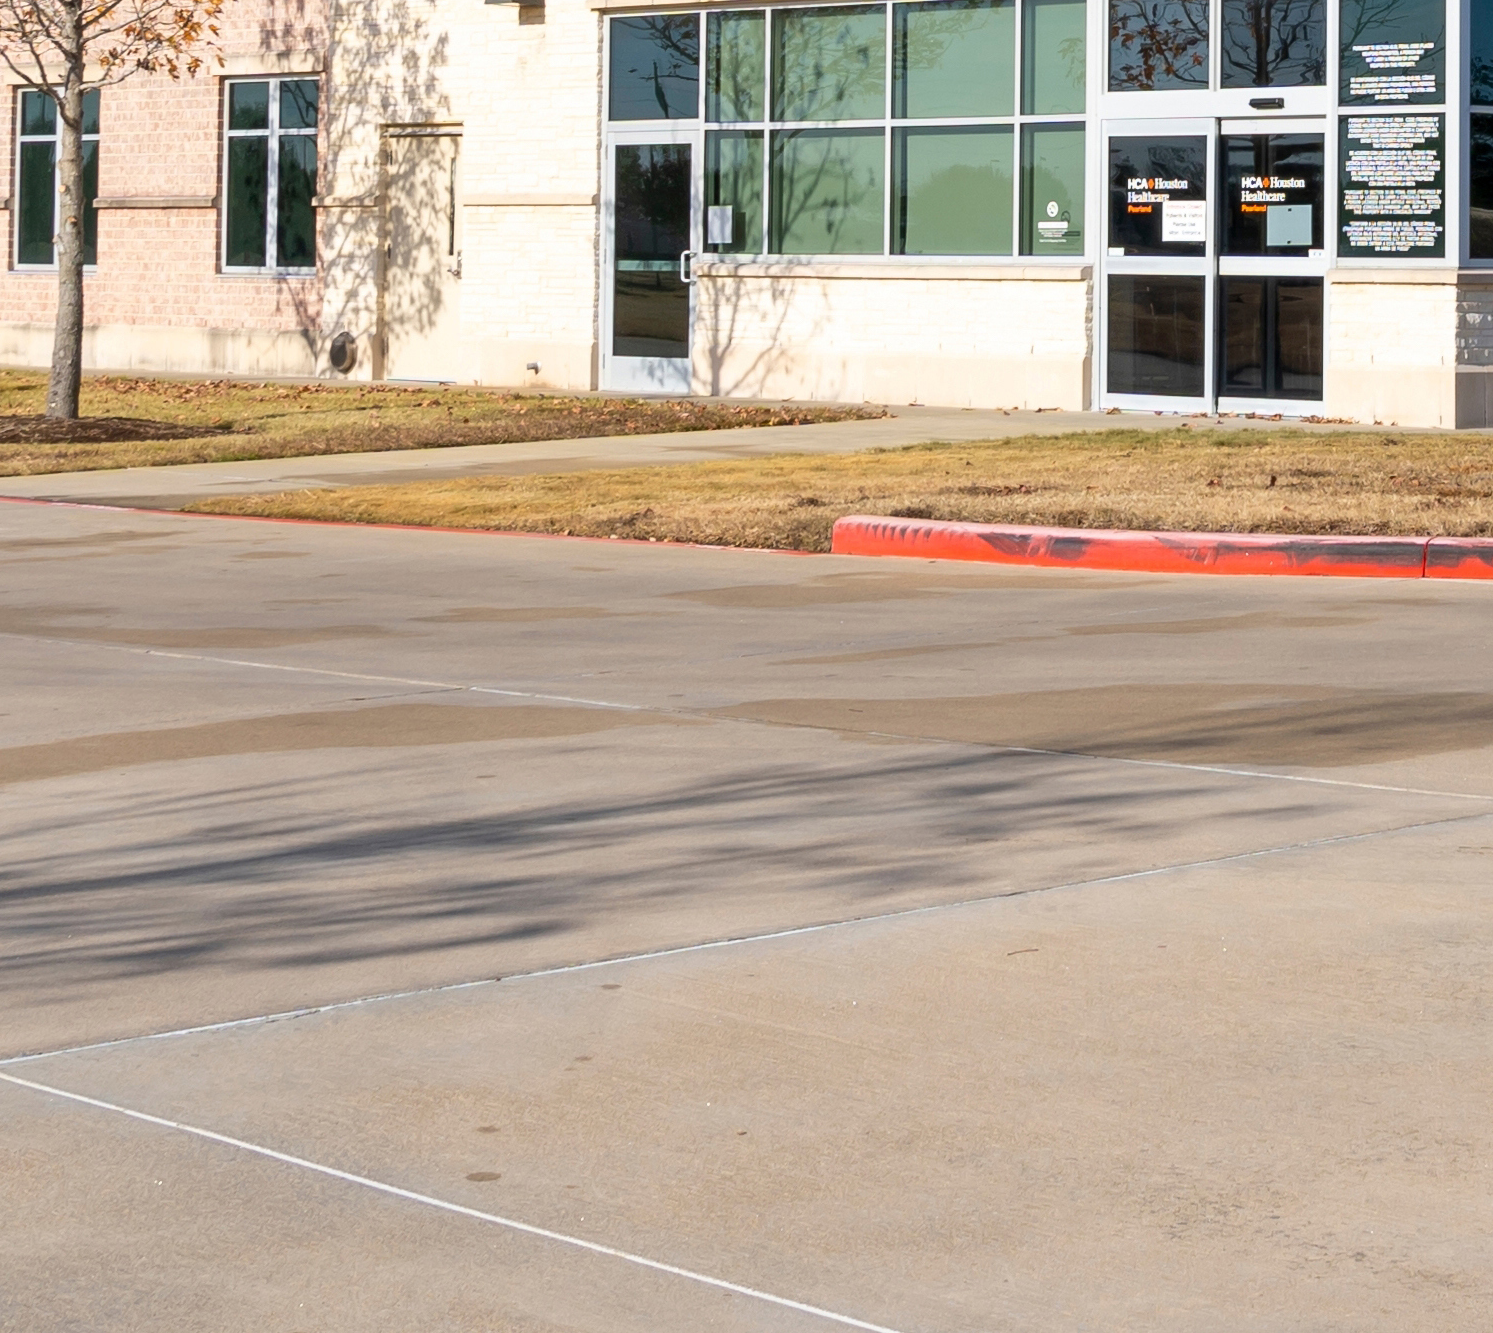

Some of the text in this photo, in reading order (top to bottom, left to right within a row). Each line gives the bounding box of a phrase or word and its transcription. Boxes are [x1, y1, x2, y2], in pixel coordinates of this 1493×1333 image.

[1128, 177, 1188, 190] HCA Houston
[1241, 176, 1305, 189] HCA Houston
[1241, 190, 1286, 202] Healthcare
